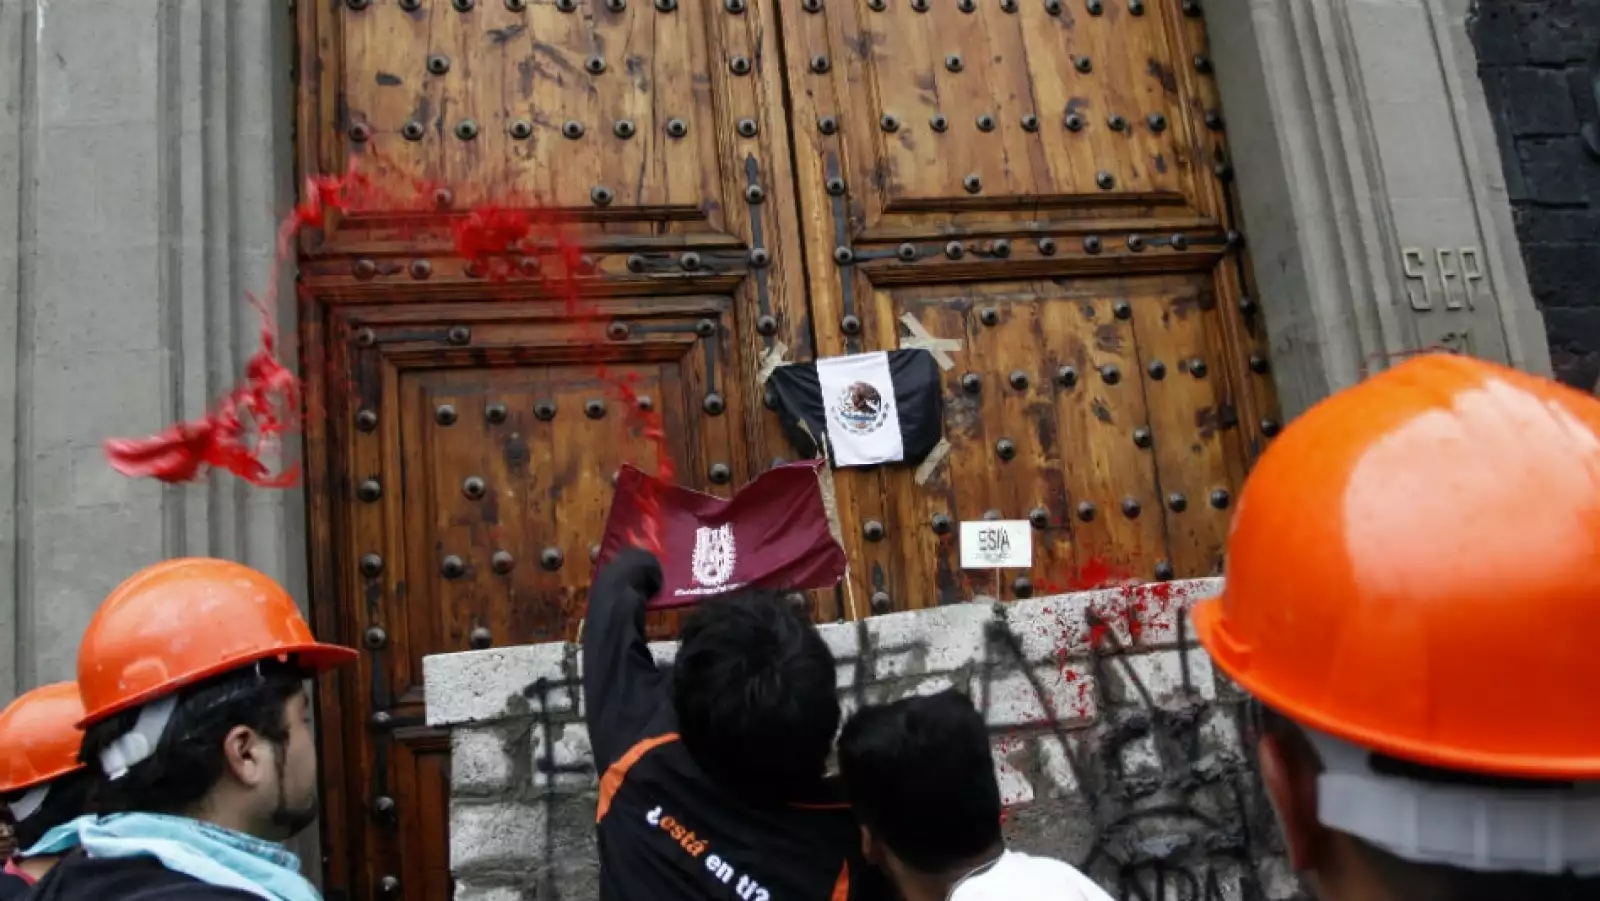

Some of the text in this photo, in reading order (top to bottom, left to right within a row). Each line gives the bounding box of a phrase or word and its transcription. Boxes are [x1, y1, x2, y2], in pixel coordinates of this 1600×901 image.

[1402, 246, 1482, 312] SEP
[977, 527, 1011, 551] ESIA
[646, 805, 709, 857] ¿está
[705, 854, 734, 884] en
